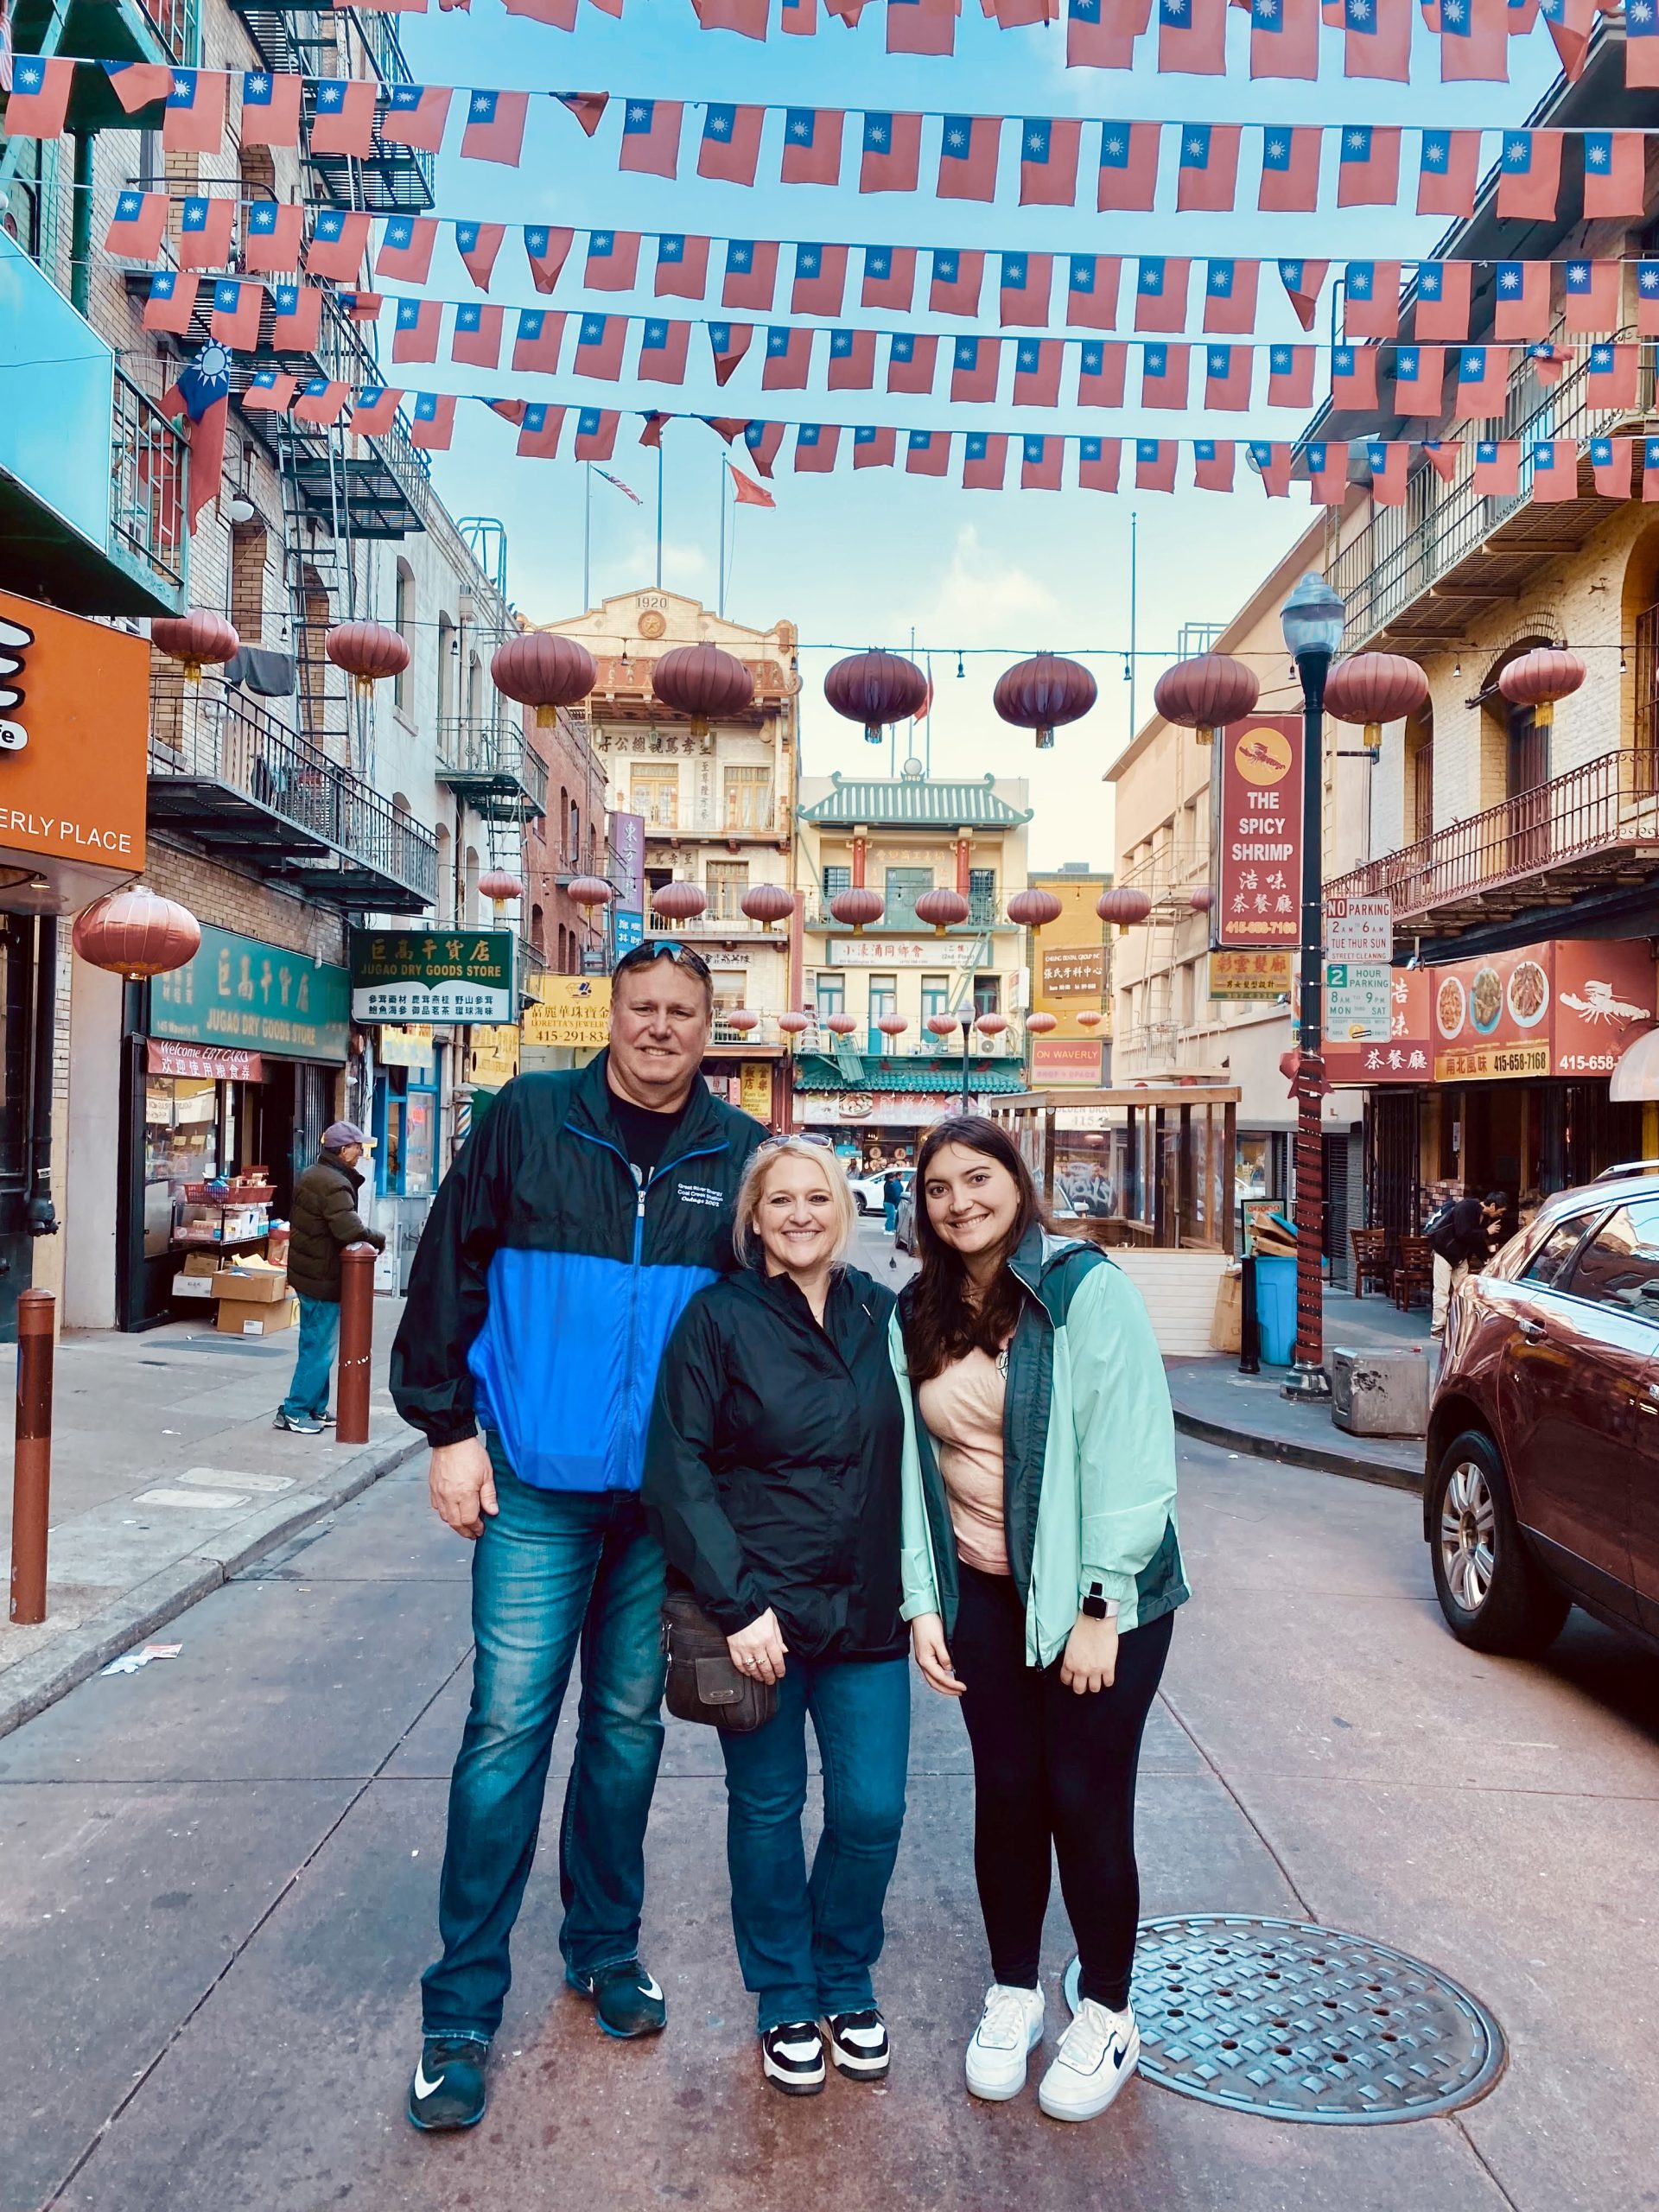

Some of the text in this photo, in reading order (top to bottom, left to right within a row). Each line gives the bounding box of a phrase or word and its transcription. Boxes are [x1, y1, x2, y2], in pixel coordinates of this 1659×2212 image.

[637, 597, 667, 608] 1920
[1247, 791, 1280, 810] THE
[1238, 817, 1286, 835] SPICY
[60, 821, 132, 854] PLACE
[1231, 843, 1294, 861] SHRIMP
[1238, 868, 1287, 891] 浩味
[1230, 892, 1294, 914] 茶餐廳
[1328, 899, 1389, 918] NO PARKING
[1332, 921, 1340, 933] 2
[1363, 921, 1370, 933] 6
[1332, 938, 1386, 949] TUE THUR SUN
[360, 963, 502, 977] JUGAO DRY GOODS STORE
[1044, 965, 1103, 979] 張氏牙科中心
[1331, 969, 1382, 986] 2 HOUR
[1350, 979, 1389, 988] PARKING
[1331, 991, 1338, 1003] 8
[1365, 991, 1373, 1003] 9
[1330, 1006, 1351, 1015] MON
[1371, 1007, 1386, 1015] SAT
[207, 1007, 240, 1034] JUGAO
[242, 1013, 260, 1038] DRY
[262, 1018, 290, 1041] GOODS
[291, 1021, 317, 1046] STORE
[160, 1040, 249, 1063] Welcome EBT CARD
[1036, 1050, 1098, 1059] ON WAVERLY
[1363, 1047, 1429, 1071] 茶餐廳
[162, 1056, 251, 1080] 欢迎使用粮食券
[1446, 1052, 1547, 1075] 南北風味 415-658-7168
[1559, 1054, 1624, 1071] 415-658-
[693, 1185, 706, 1193] River
